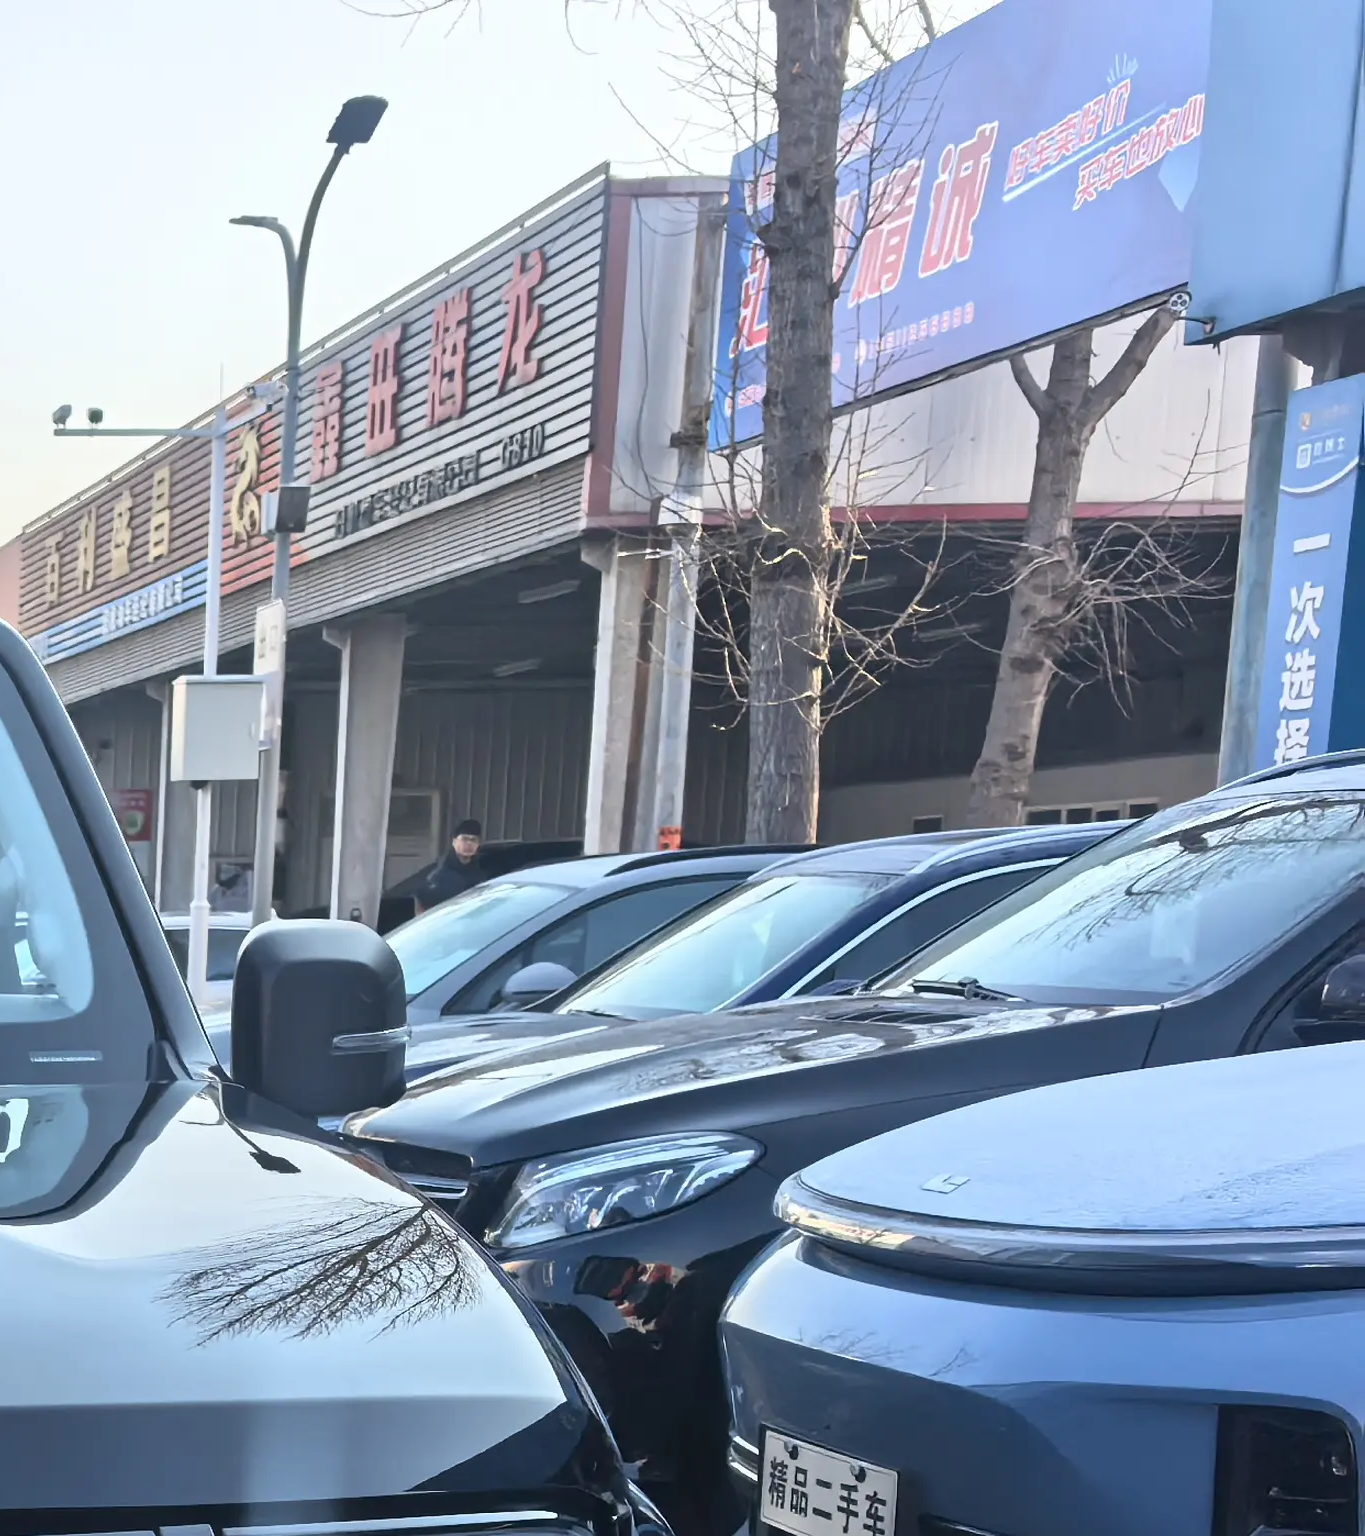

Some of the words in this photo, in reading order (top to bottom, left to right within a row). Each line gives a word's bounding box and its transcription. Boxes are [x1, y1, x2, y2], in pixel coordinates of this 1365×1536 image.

[1004, 78, 1131, 191] 好车卖好价
[1073, 93, 1205, 211] 买车也放心
[309, 248, 547, 485] 鑫旺腾龙
[1273, 532, 1332, 766] 一次选择
